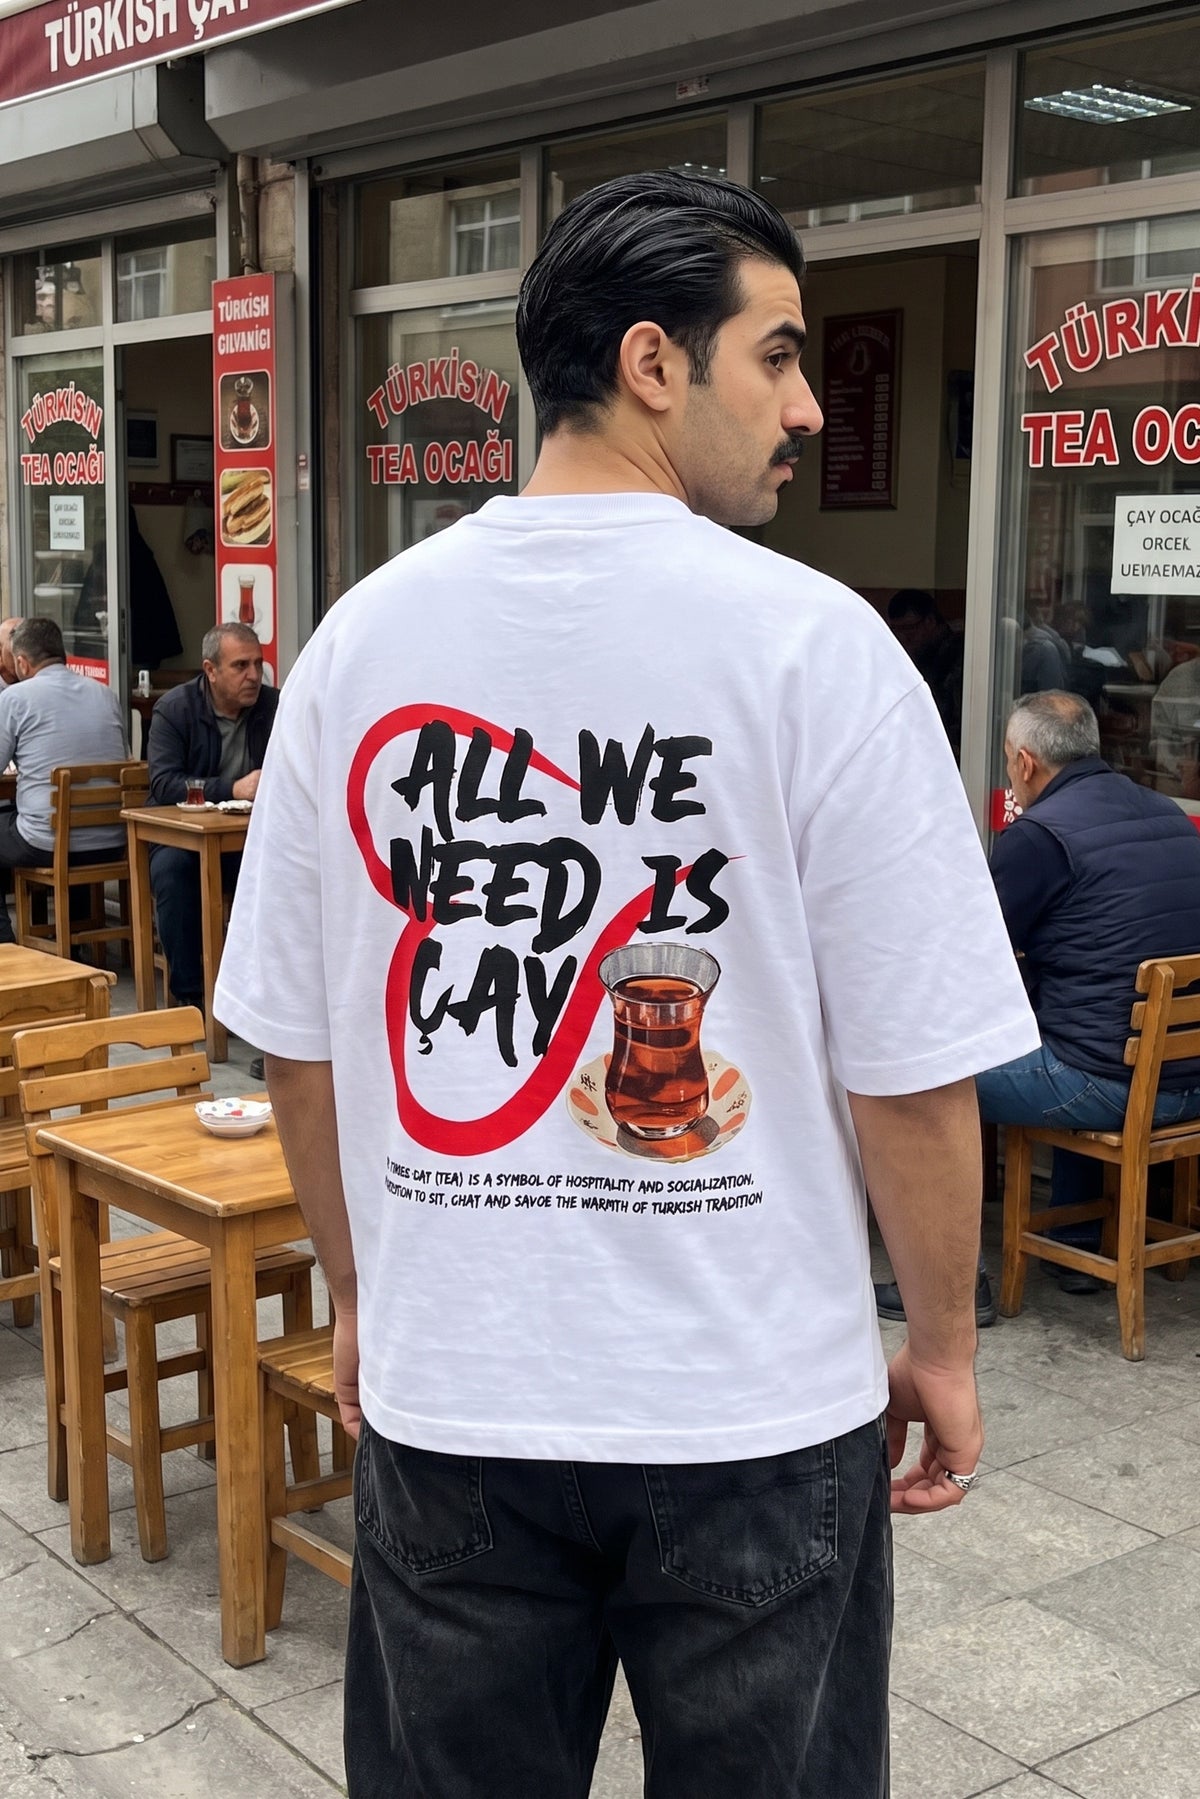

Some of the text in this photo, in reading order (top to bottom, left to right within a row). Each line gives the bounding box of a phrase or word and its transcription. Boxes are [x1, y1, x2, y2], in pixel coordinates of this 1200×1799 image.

[21, 443, 104, 485] TEA OCAĞI
[366, 429, 513, 484] TEA OCAĞI
[1021, 409, 1120, 467] TEA
[1127, 510, 1156, 527] ÇAY
[390, 720, 713, 842] ALL WE
[390, 824, 730, 954] NEED IS
[409, 937, 578, 1068] ÇAY
[414, 1189, 426, 1203] TO
[428, 1192, 448, 1208] SIT,
[451, 1194, 481, 1209] CHAT
[484, 1195, 511, 1210] AND
[556, 1195, 577, 1209] THE
[581, 1197, 629, 1213] WARMTH
[632, 1201, 648, 1214] OF
[651, 1200, 703, 1215] TURKISH
[705, 1191, 763, 1213] TRADITION
[435, 1170, 464, 1187] (TEA)
[468, 1174, 480, 1186] IS
[483, 1173, 492, 1188] A
[496, 1174, 544, 1187] SYMBOL
[546, 1175, 563, 1188] OF
[566, 1175, 635, 1192] HOSPITALITY
[637, 1180, 664, 1195] AND
